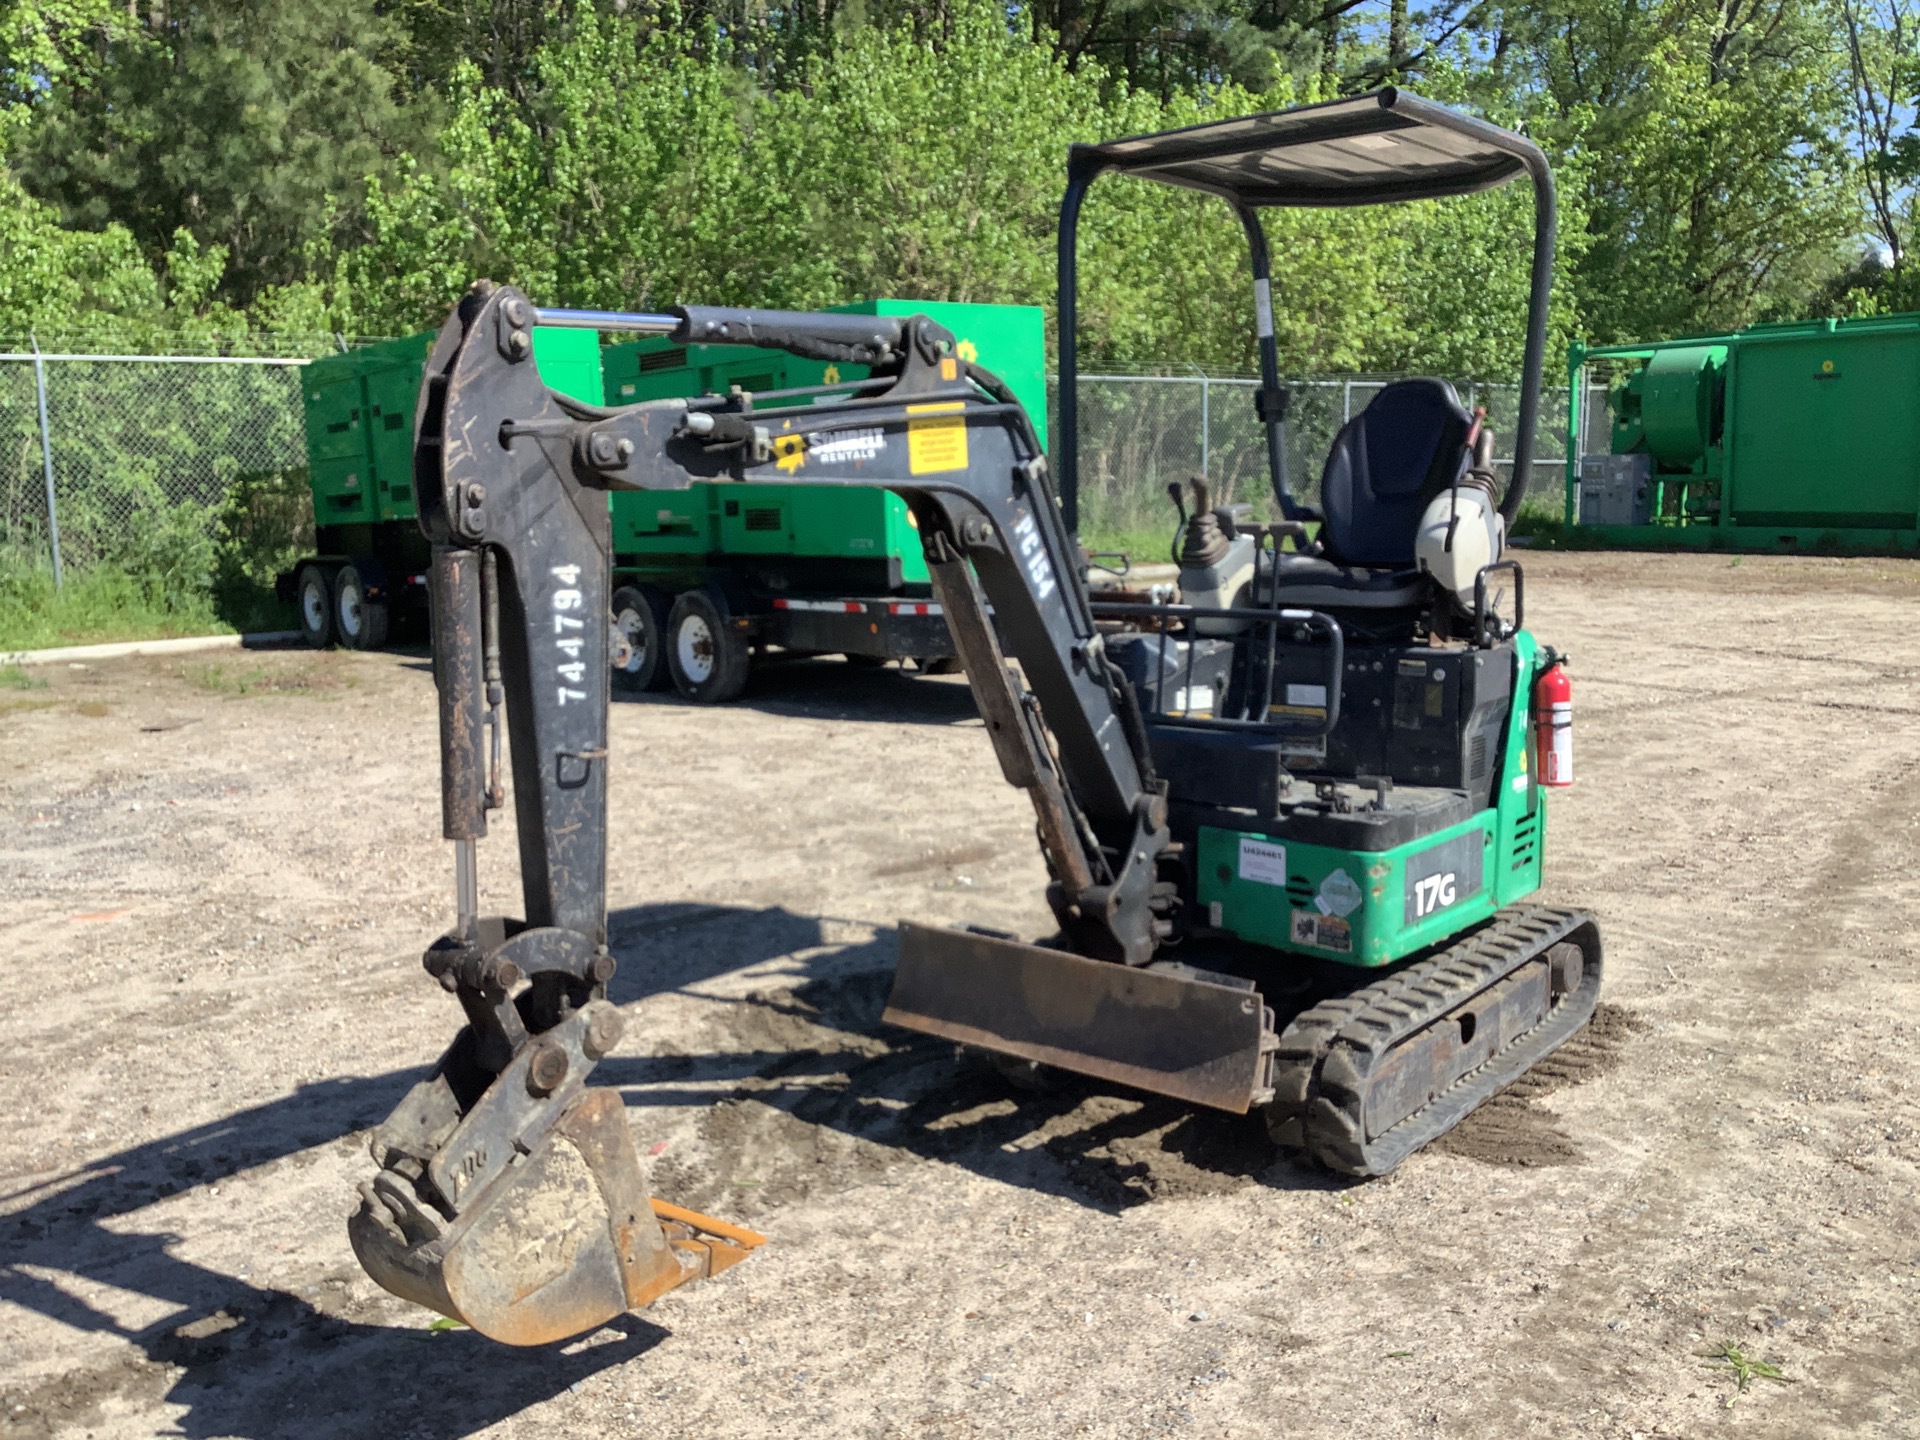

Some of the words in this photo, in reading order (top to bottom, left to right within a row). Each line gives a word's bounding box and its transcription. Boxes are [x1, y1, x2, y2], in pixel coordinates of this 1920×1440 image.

[820, 449, 876, 463] RENTALS
[552, 564, 587, 706] 744794
[1415, 873, 1455, 917] 17G
